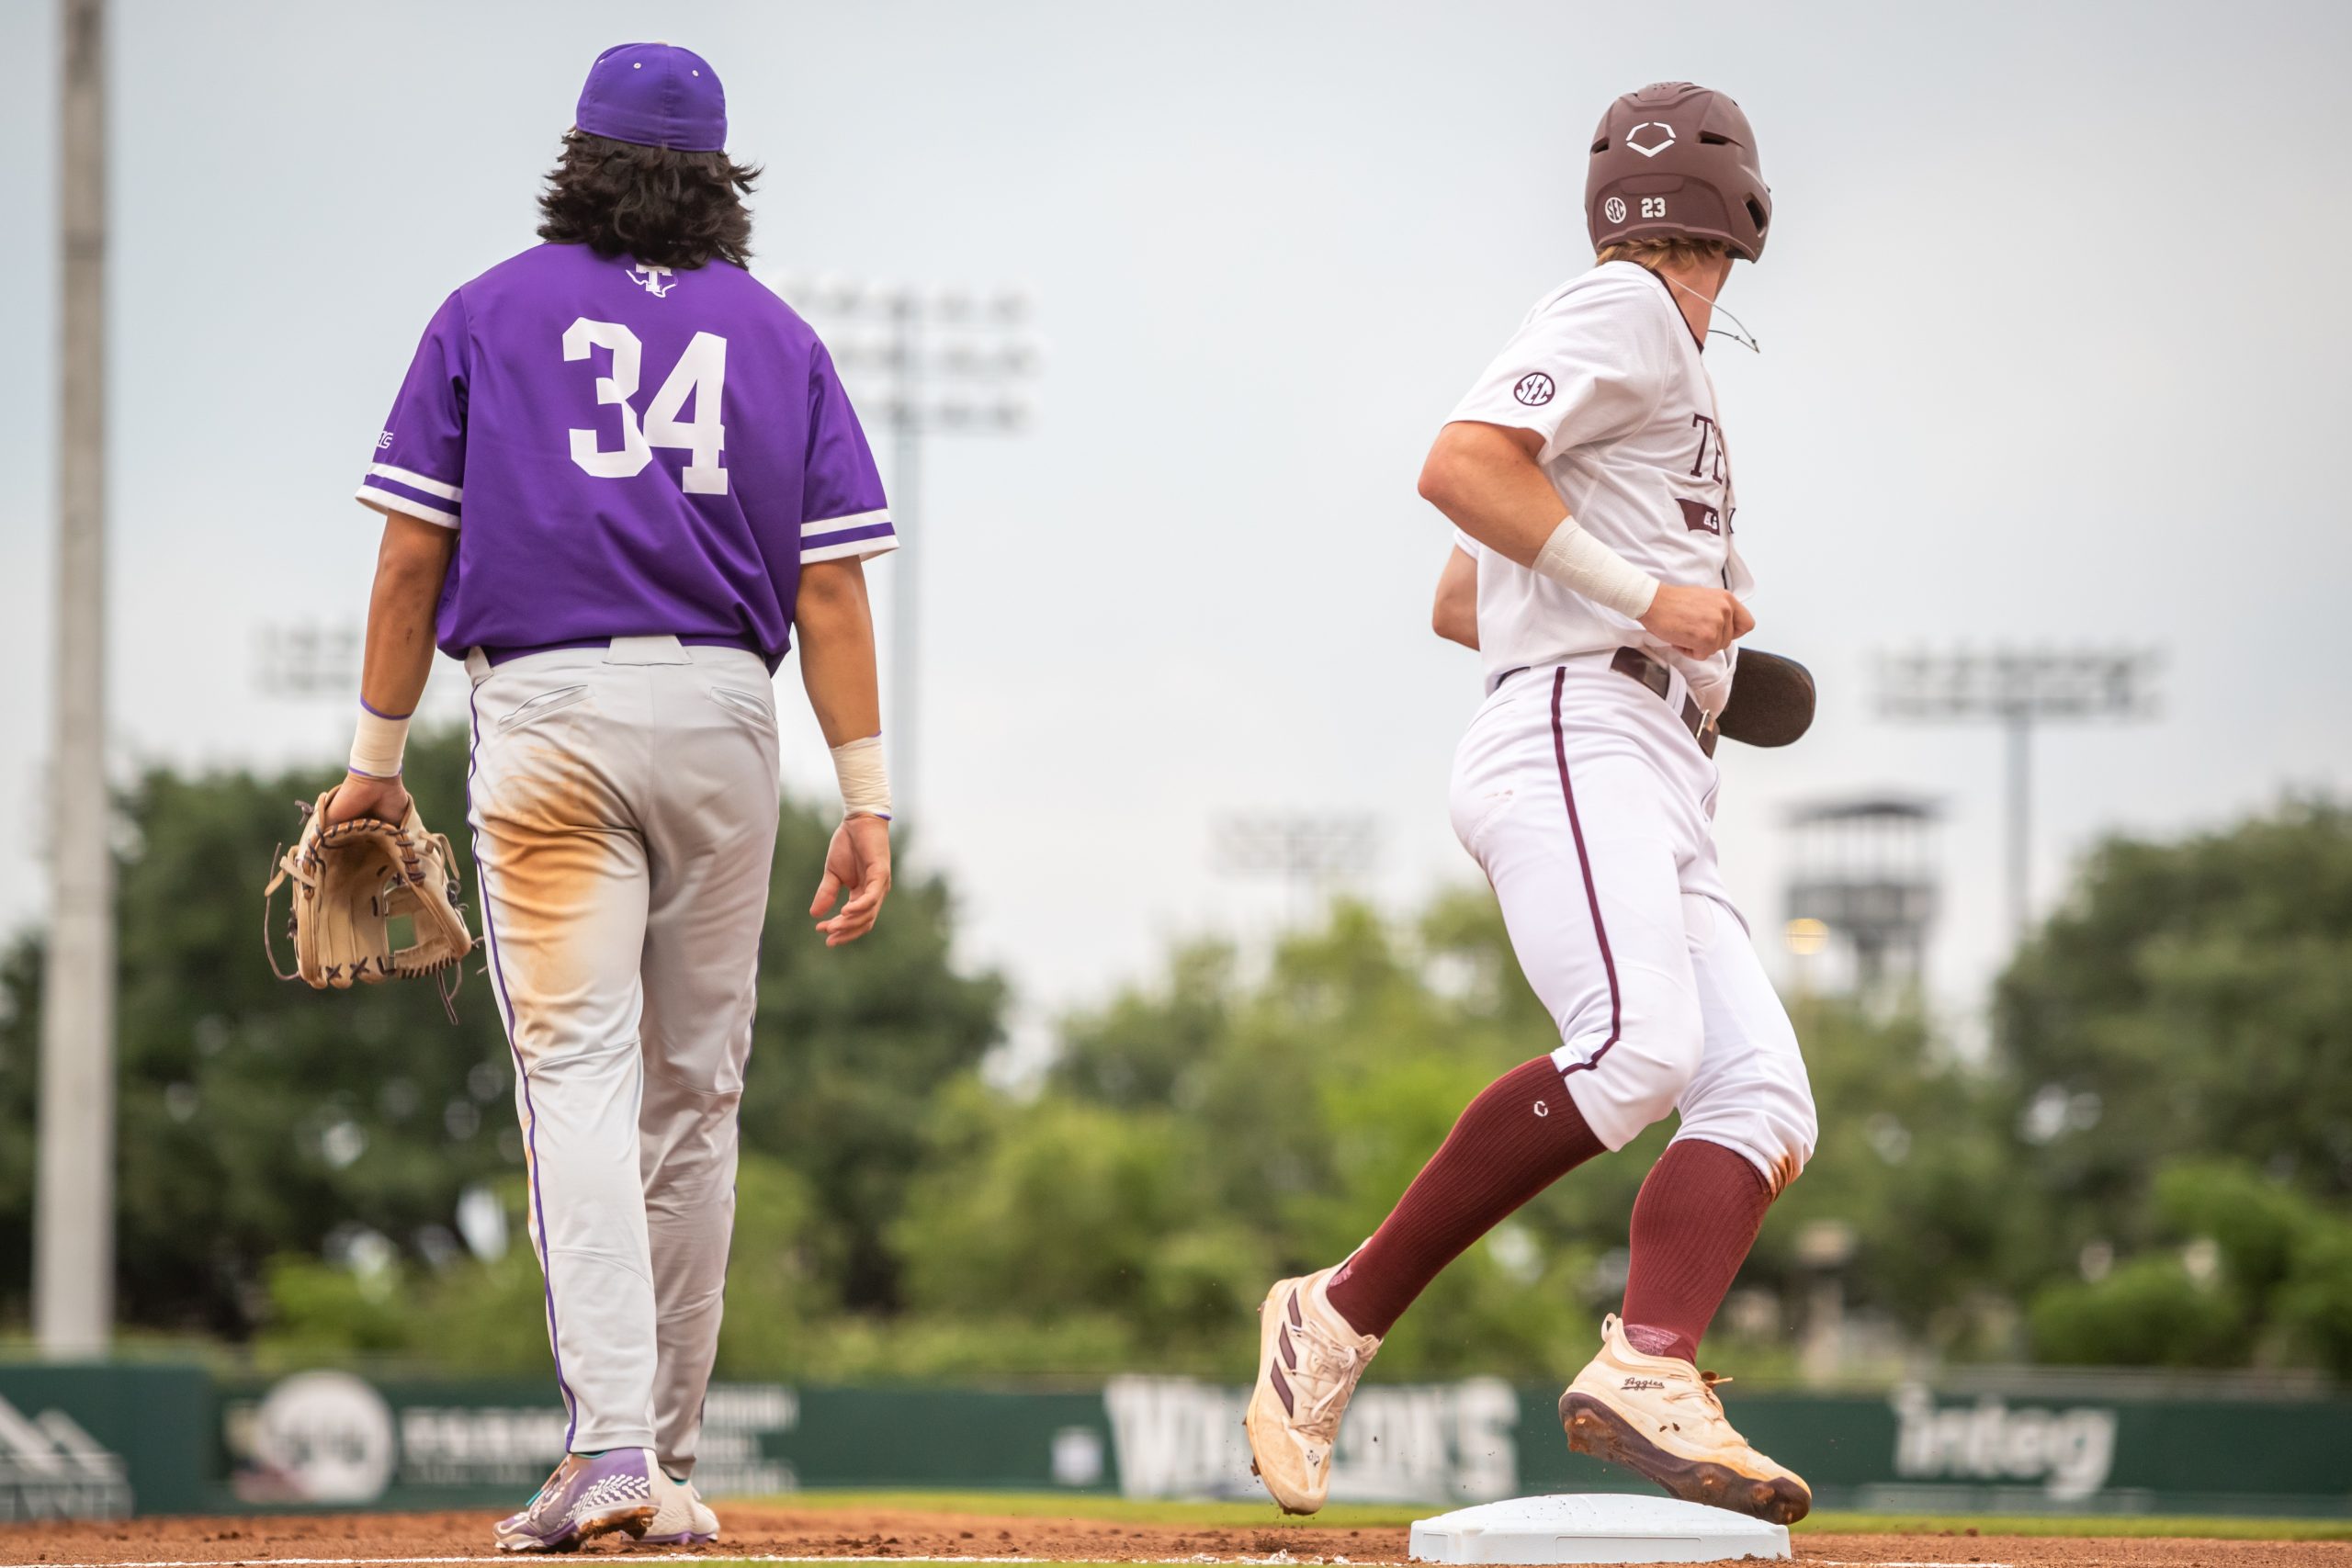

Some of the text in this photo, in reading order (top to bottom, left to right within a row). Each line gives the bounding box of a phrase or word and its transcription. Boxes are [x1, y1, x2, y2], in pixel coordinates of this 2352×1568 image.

[1606, 198, 1625, 221] SEC
[1641, 197, 1666, 218] 23
[1516, 374, 1554, 405] SEC
[561, 316, 729, 496] 34
[1623, 1377, 1665, 1391] Aggies
